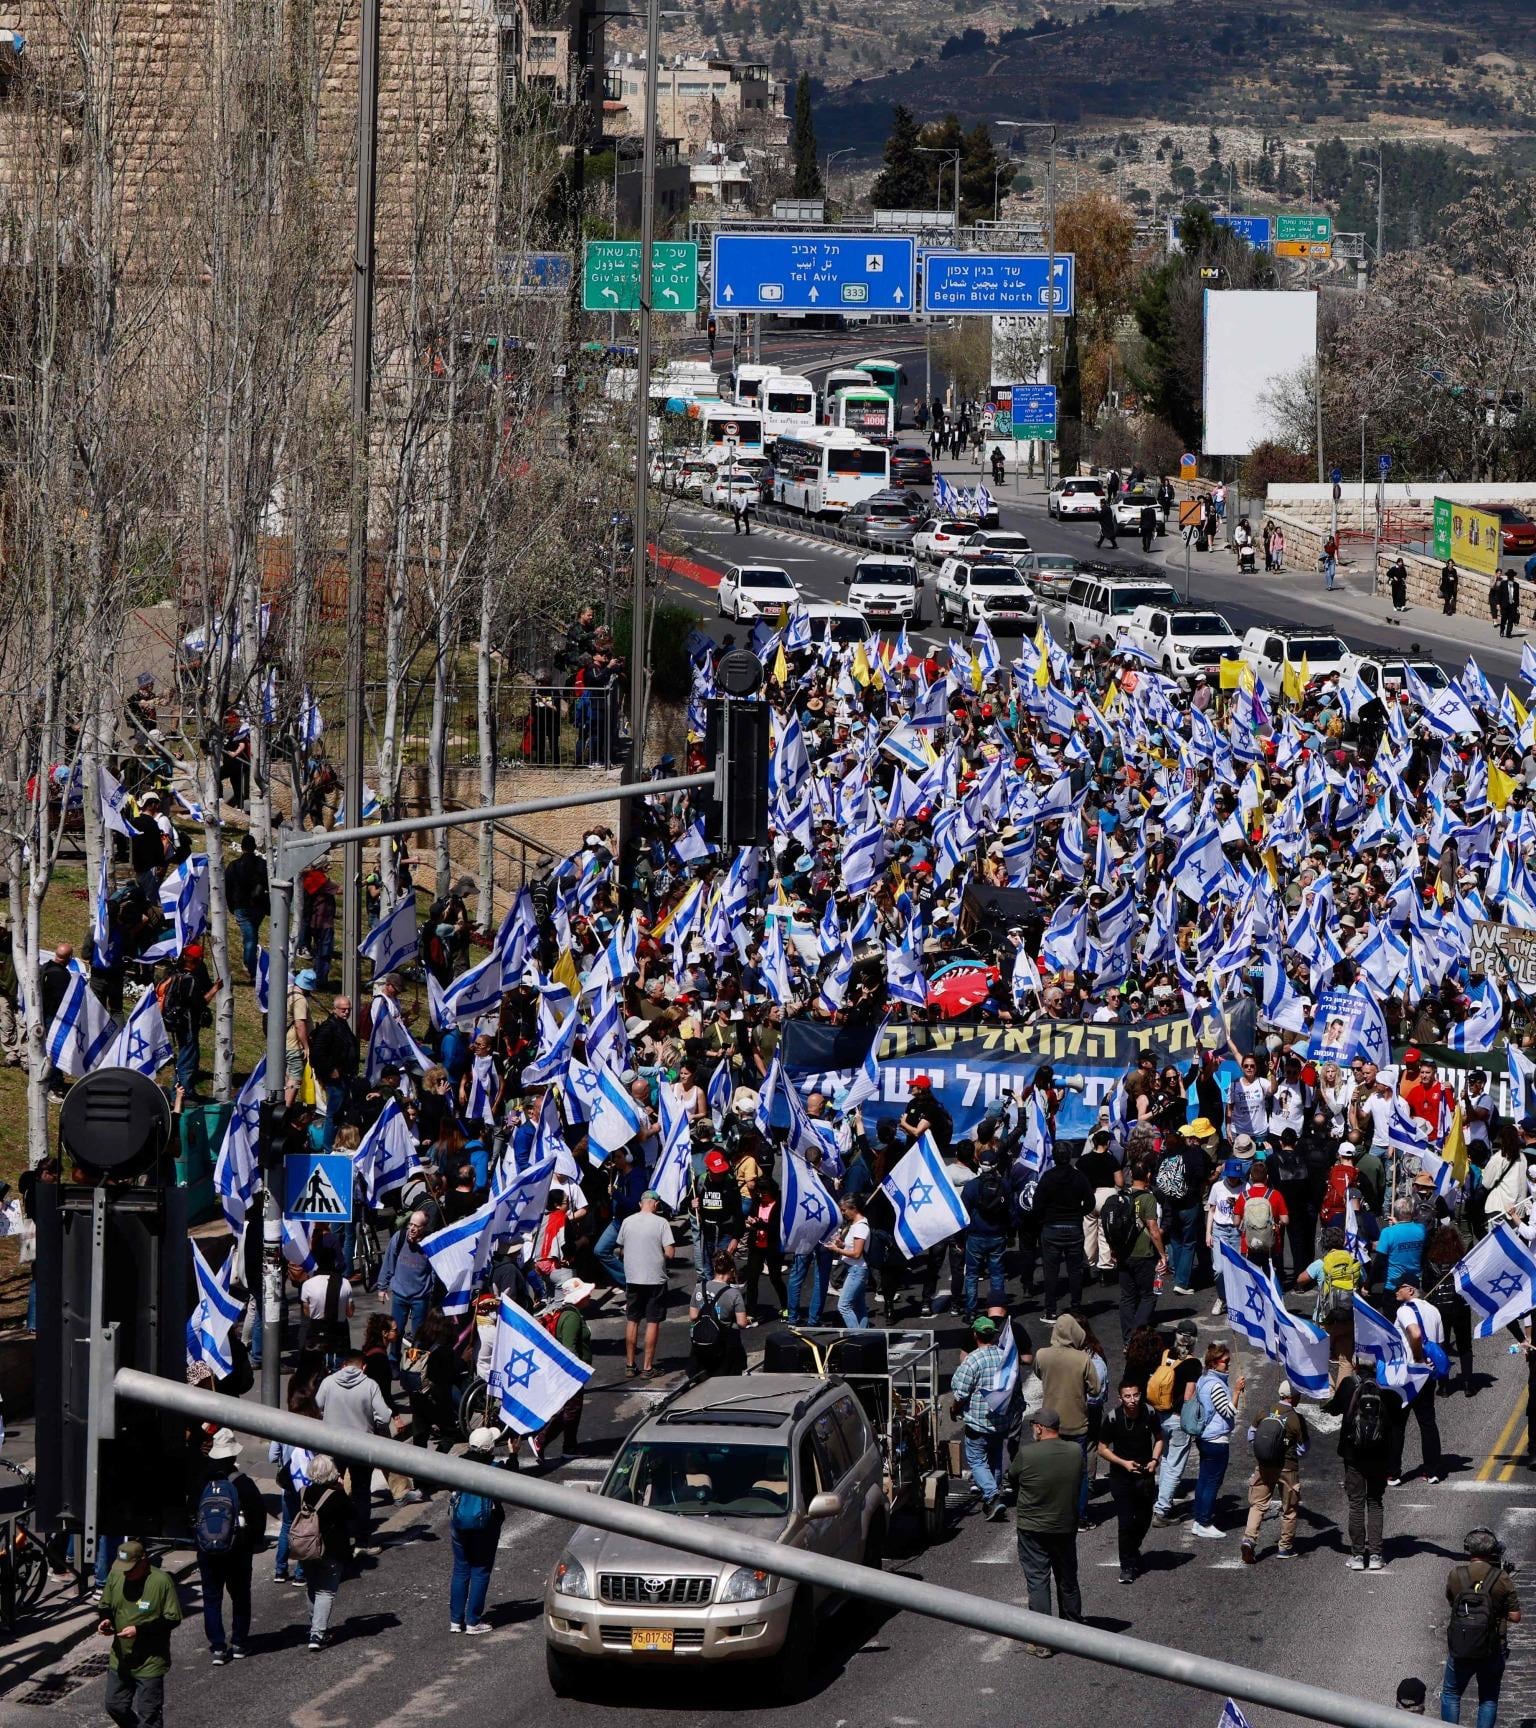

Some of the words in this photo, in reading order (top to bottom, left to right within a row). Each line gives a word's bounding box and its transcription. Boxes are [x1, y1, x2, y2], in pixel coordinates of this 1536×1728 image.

[595, 245, 624, 257] שאול
[791, 244, 817, 254] אביב
[824, 243, 840, 254] תל
[821, 259, 832, 271] تل
[790, 272, 807, 281] Tel
[813, 272, 838, 281] Aviv
[947, 265, 969, 277] צפון
[974, 266, 994, 277] בגין
[670, 274, 689, 284] Qtr
[940, 279, 967, 289] شمال
[769, 288, 775, 297] 1
[845, 288, 864, 297] 333
[934, 292, 966, 303] Begin
[971, 292, 995, 301] Blvd
[1000, 292, 1033, 302] North
[867, 416, 886, 426] 1000
[1182, 529, 1198, 541] 30
[1472, 922, 1509, 949] WE
